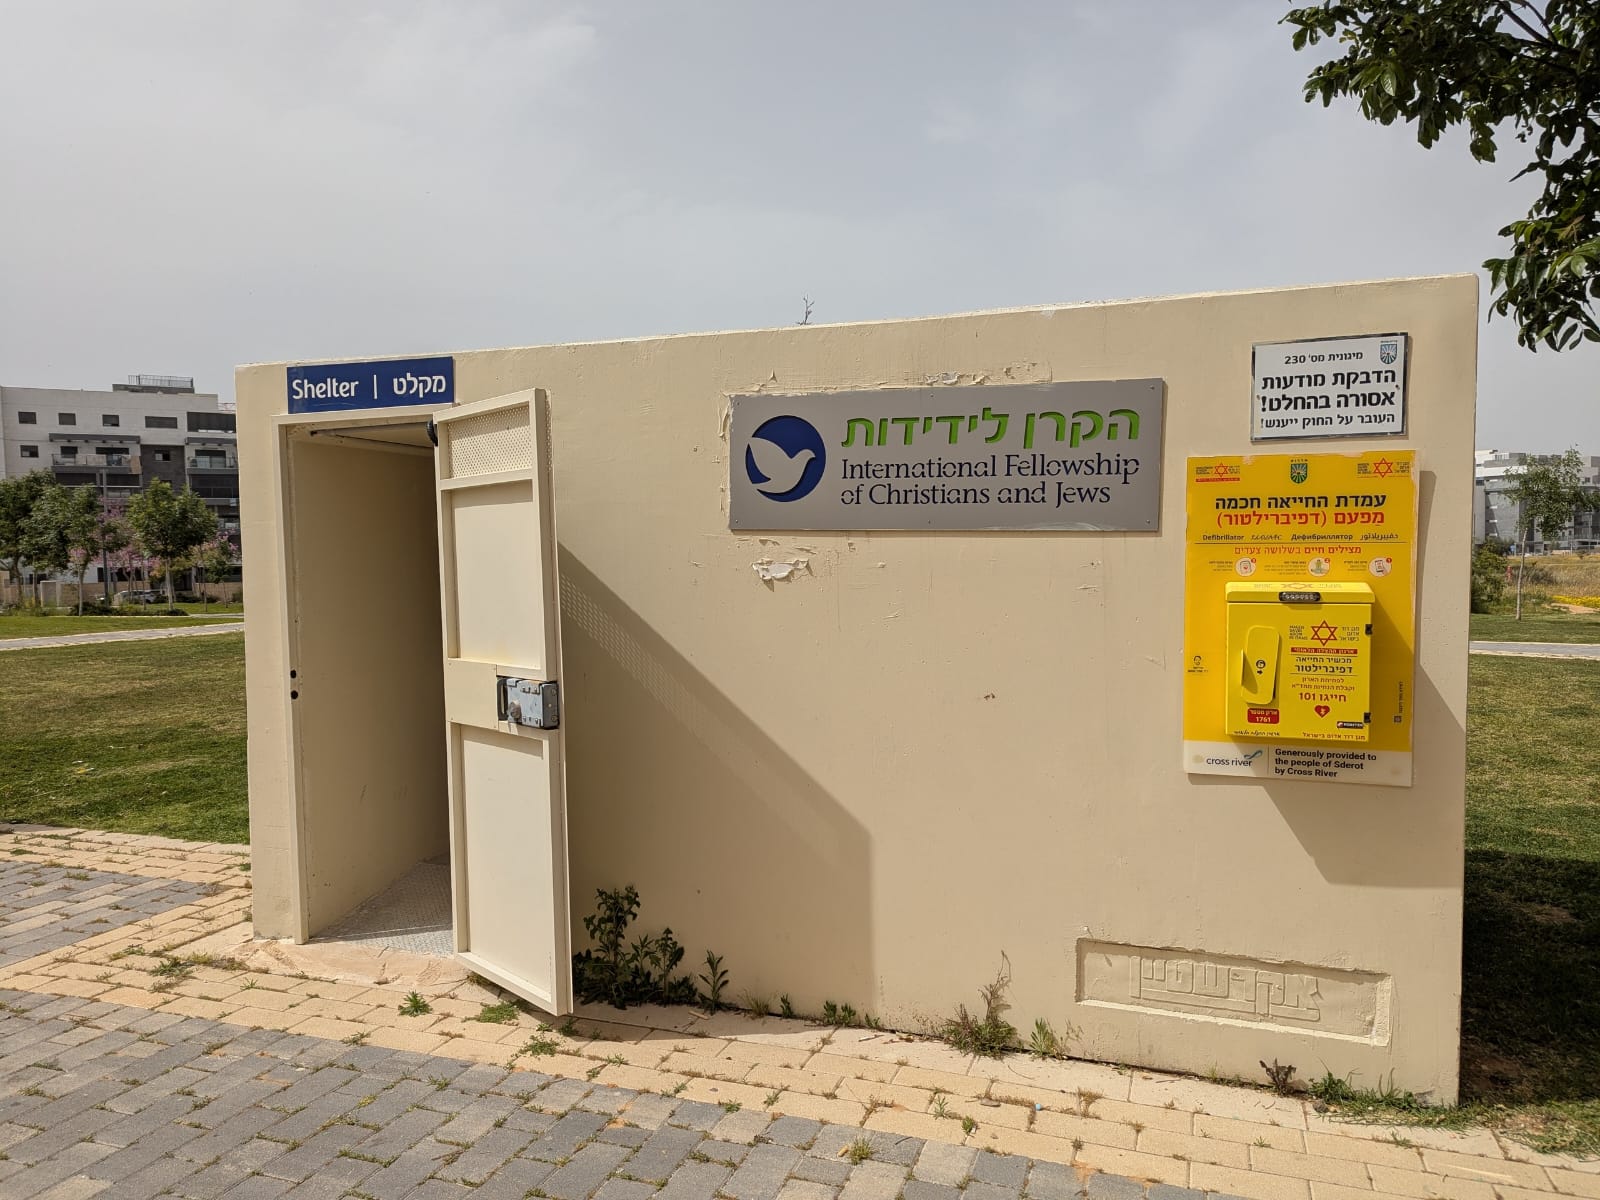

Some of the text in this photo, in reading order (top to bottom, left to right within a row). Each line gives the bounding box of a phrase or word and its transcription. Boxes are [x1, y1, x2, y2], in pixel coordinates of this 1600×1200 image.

[1284, 355, 1306, 364] 230
[1328, 352, 1363, 361] מיגונית
[393, 372, 446, 398] מקלט
[1262, 370, 1396, 390] הדבקת מודעות
[292, 377, 359, 400] Shelter
[1261, 391, 1396, 412] אסורה בהחלט!
[1302, 416, 1333, 429] החוק
[1337, 414, 1353, 424] על
[1358, 413, 1395, 424] העובר
[841, 407, 1140, 449] הקרן לידידות
[841, 452, 1140, 485] International Fellowship
[841, 482, 1111, 508] of Christians and Jews
[1216, 494, 1386, 510] עמדת החייאה חכמה
[1217, 510, 1327, 528] (דפיברילטור)
[1291, 533, 1353, 541] Дефибриллятор
[1234, 544, 1362, 555] מצילים חיים בשלושה צעדים
[1295, 664, 1352, 673] דפיברילטור
[1299, 692, 1346, 702] חייגו 101
[1206, 756, 1252, 767] cross river
[1275, 749, 1324, 760] Generously
[1326, 751, 1365, 762] provided
[1275, 757, 1364, 770] the people of Sderot
[1274, 767, 1338, 778] by Cross River
